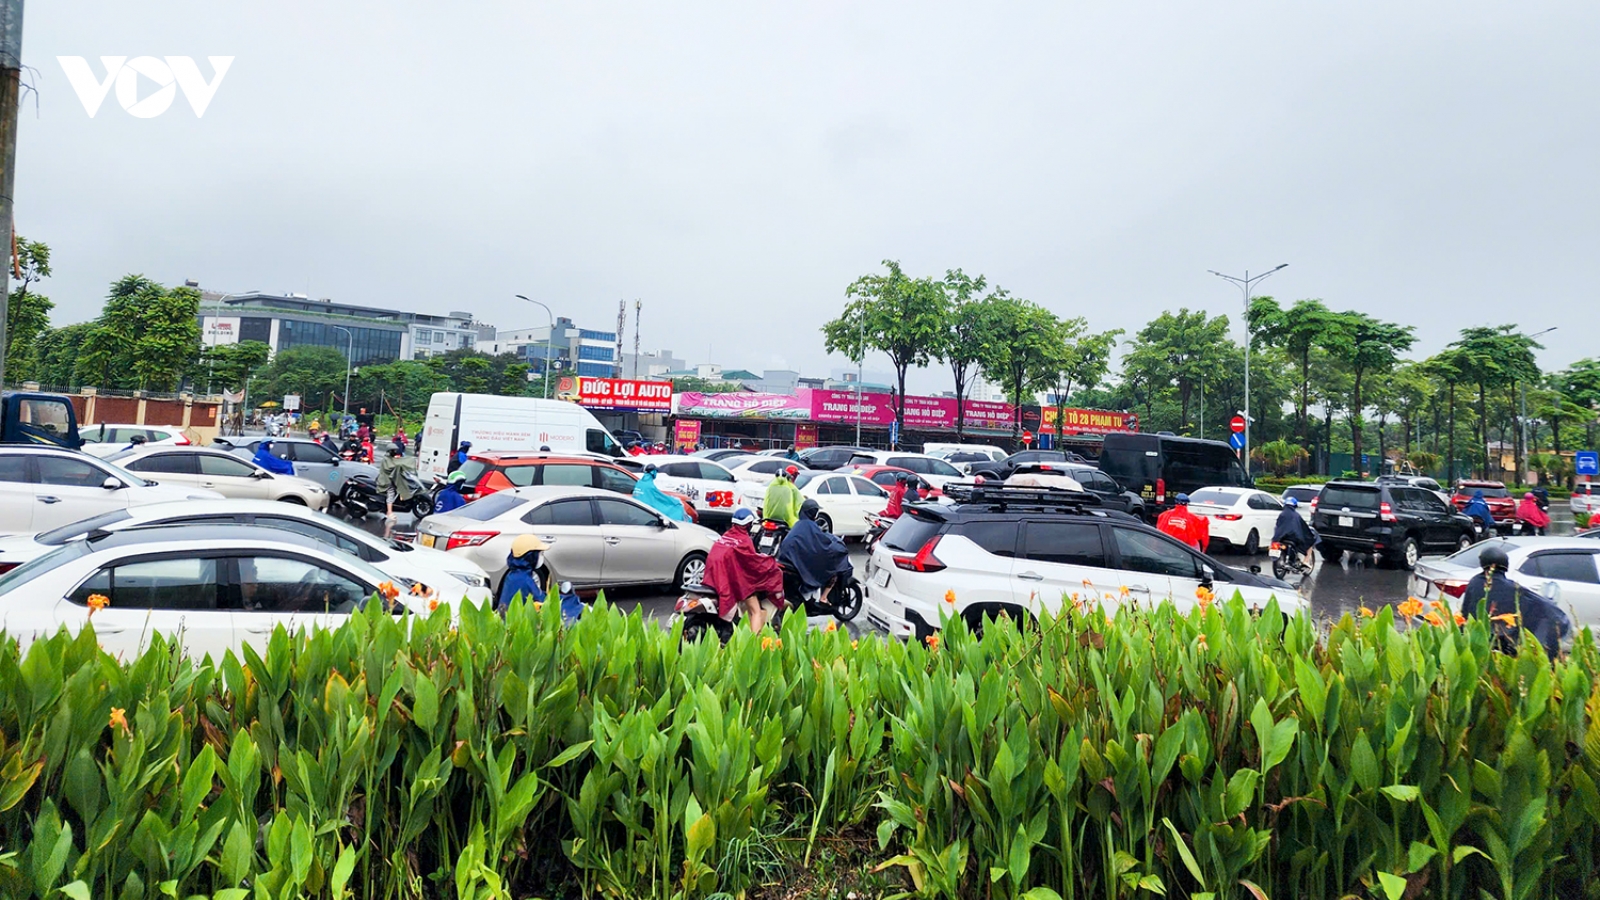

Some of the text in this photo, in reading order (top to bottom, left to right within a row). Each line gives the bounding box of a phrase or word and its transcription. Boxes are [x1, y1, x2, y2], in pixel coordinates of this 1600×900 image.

[582, 379, 671, 398] ĐỨC LỢI AUTO
[704, 397, 740, 407] TRANG
[823, 403, 848, 412] TRANG
[922, 406, 930, 416] HỒ
[932, 409, 946, 418] ĐIỆP
[987, 410, 995, 419] HỒ
[996, 412, 1010, 420] ĐIỆP
[1069, 411, 1078, 424] TÔ
[1080, 413, 1089, 425] 28
[1090, 414, 1111, 428] PHẠM
